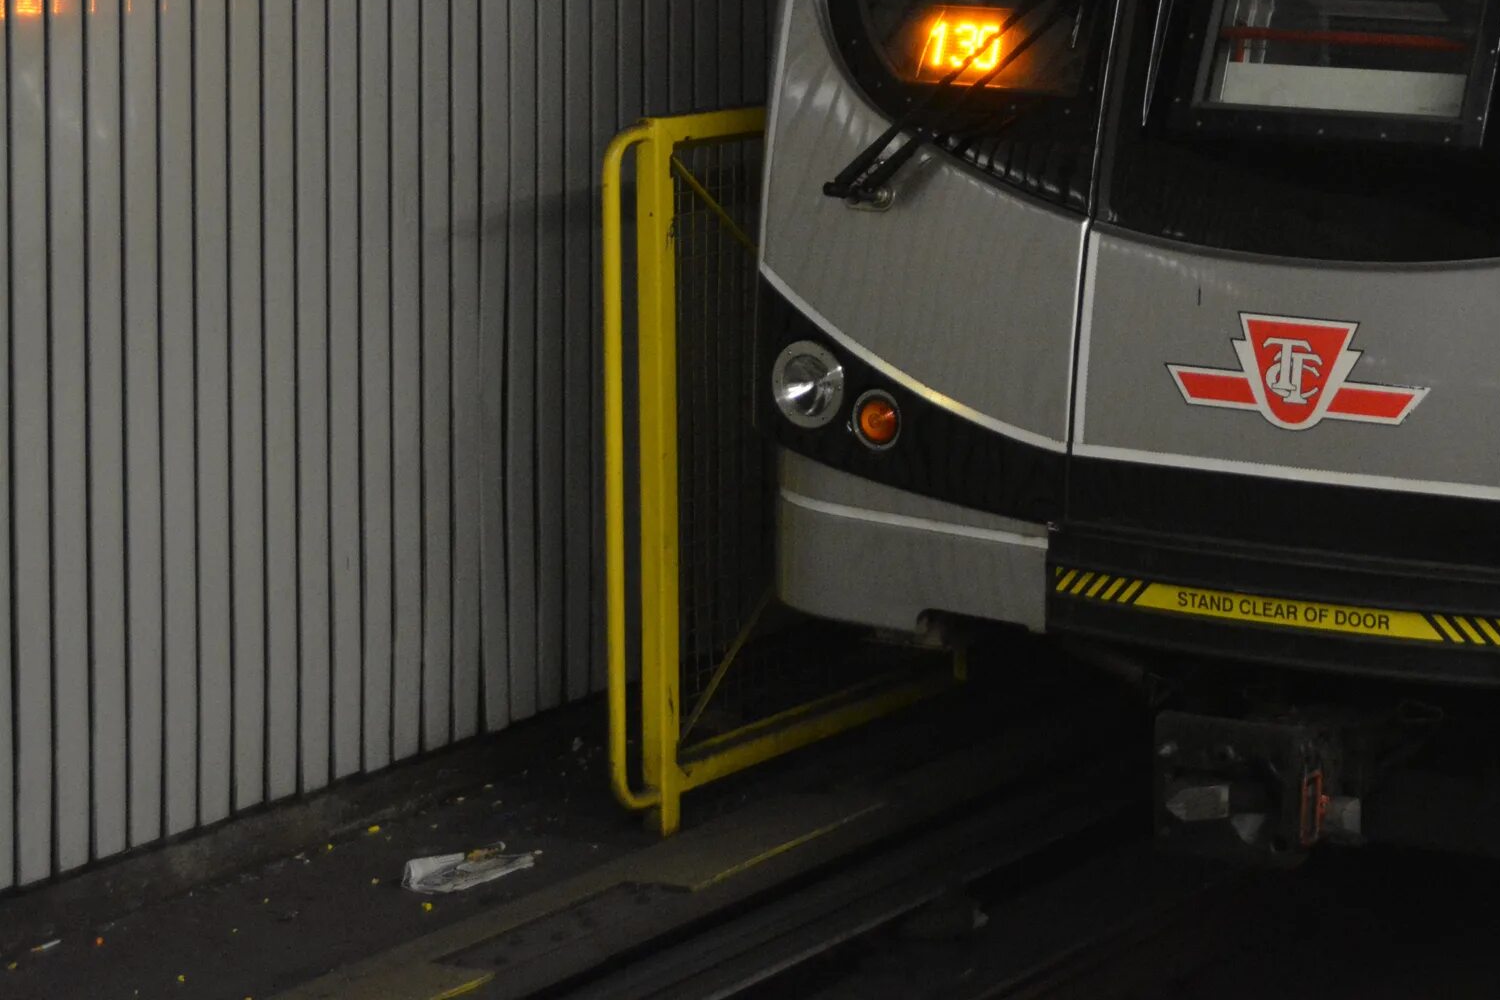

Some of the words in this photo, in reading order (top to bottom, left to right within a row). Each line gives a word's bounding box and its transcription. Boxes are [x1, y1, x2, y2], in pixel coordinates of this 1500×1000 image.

[1262, 336, 1324, 405] TTC
[1177, 590, 1234, 613] STAND
[1239, 599, 1298, 621] CLEAR
[1303, 606, 1330, 624] OF
[1334, 610, 1390, 631] DOOR
